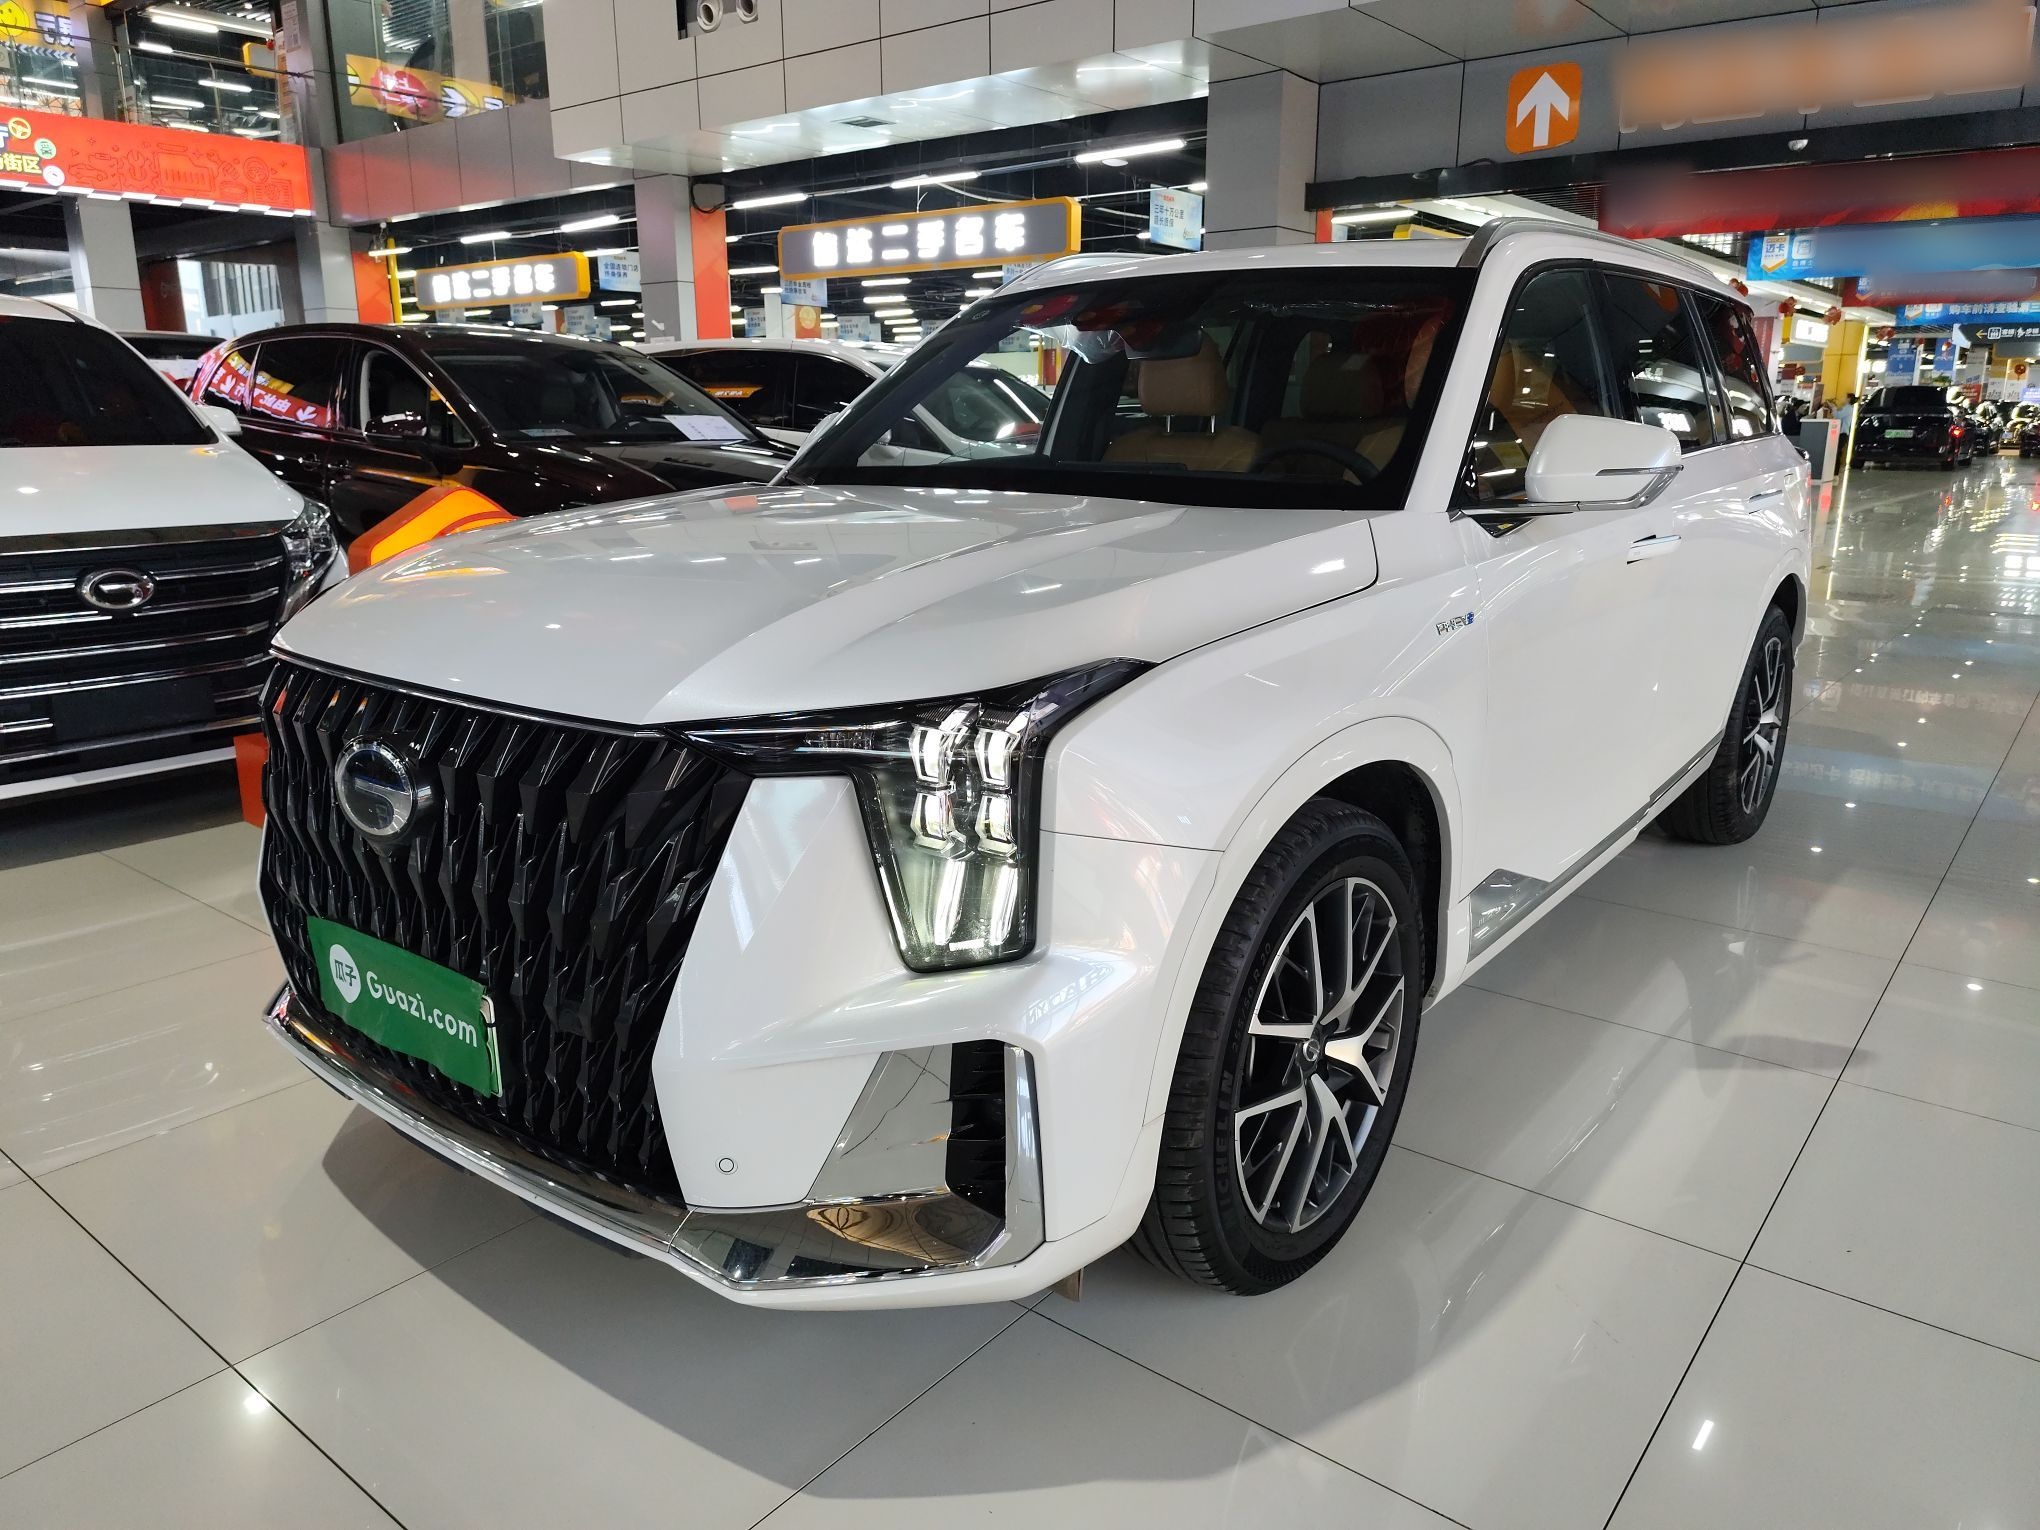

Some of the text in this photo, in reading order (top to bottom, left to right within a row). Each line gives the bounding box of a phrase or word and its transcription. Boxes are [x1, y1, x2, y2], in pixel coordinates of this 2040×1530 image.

[812, 213, 1026, 267] 二手名车
[334, 959, 357, 987] 瓜子
[1260, 942, 1272, 968] 20
[366, 970, 478, 1048] Guazi.com
